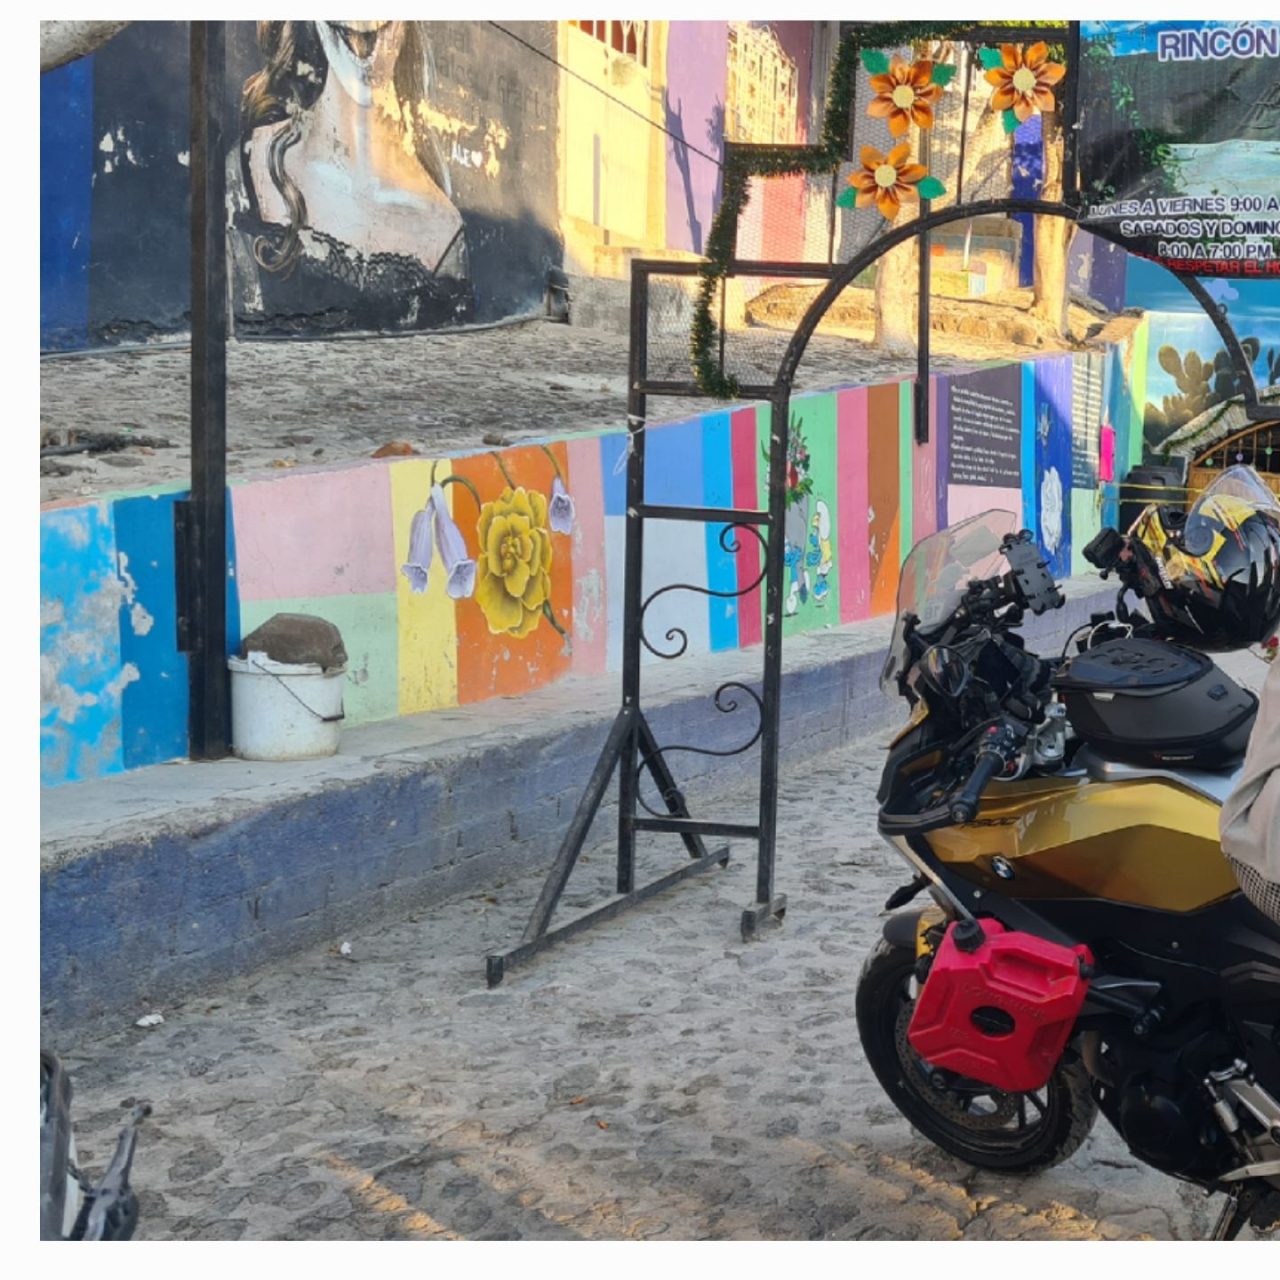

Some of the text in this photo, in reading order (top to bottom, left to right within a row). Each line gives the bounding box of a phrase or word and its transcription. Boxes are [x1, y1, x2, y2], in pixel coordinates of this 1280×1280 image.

[1158, 24, 1278, 61] RINCÓN
[1141, 199, 1156, 216] A
[1158, 196, 1226, 214] VIERNES
[1229, 196, 1263, 213] 9:00
[1266, 196, 1280, 212] A
[1204, 220, 1217, 237] Y
[1193, 244, 1206, 259] A
[1243, 260, 1262, 274] EL
